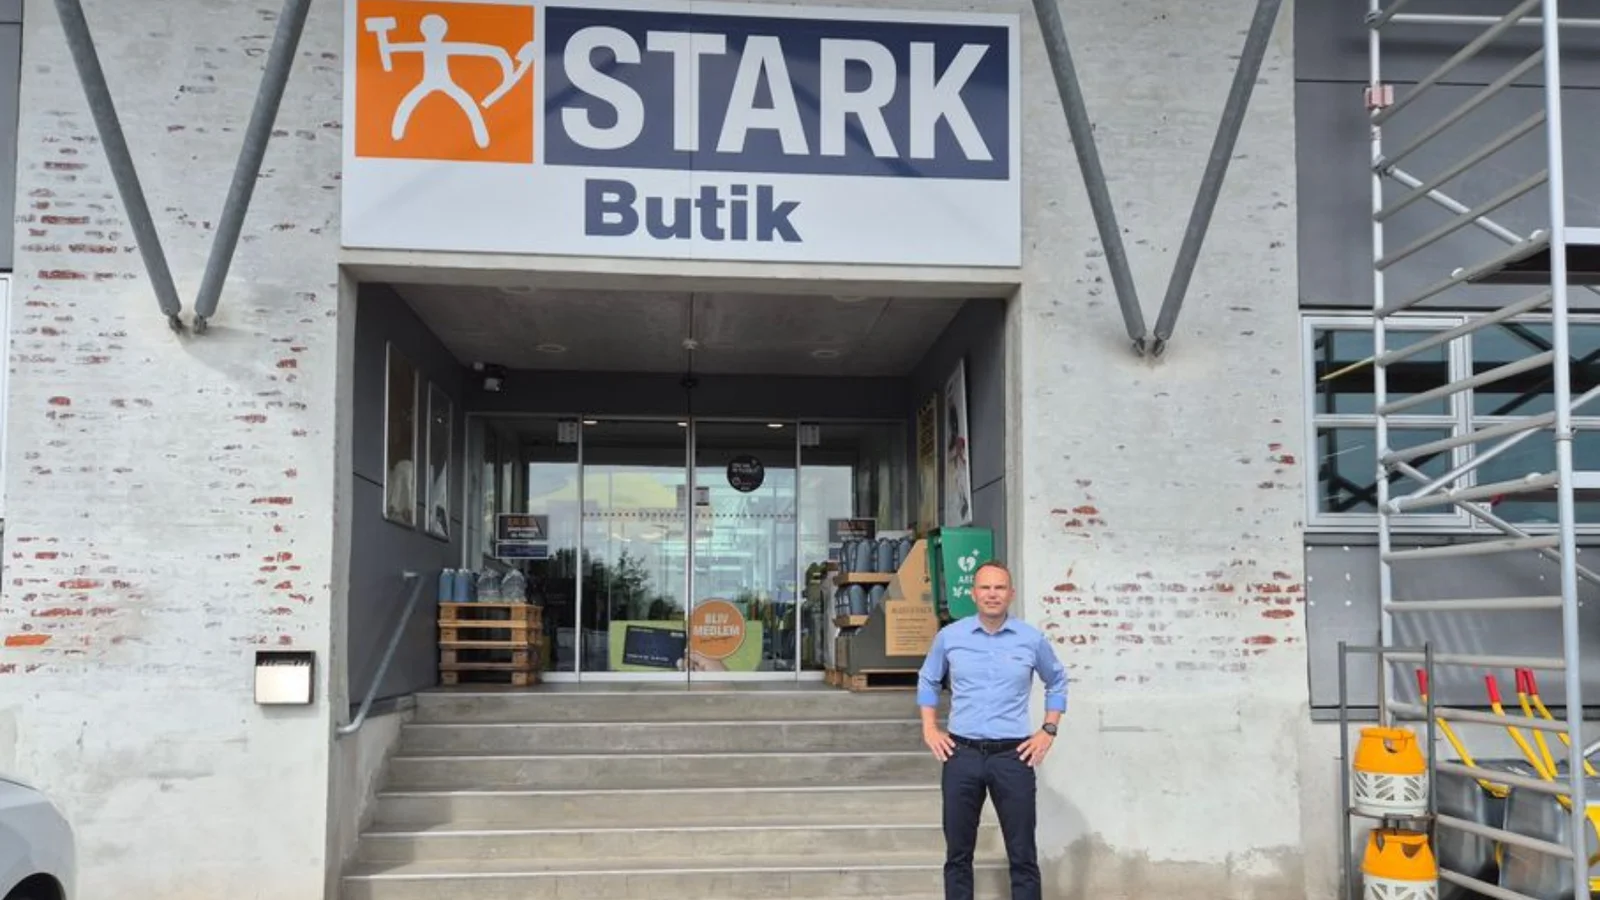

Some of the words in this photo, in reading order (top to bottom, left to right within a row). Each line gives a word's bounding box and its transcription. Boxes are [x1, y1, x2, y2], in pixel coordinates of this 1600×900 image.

[561, 25, 994, 162] STARK
[584, 178, 803, 243] Butik
[692, 624, 740, 637] MEDLEM
[704, 611, 730, 624] BLIV
